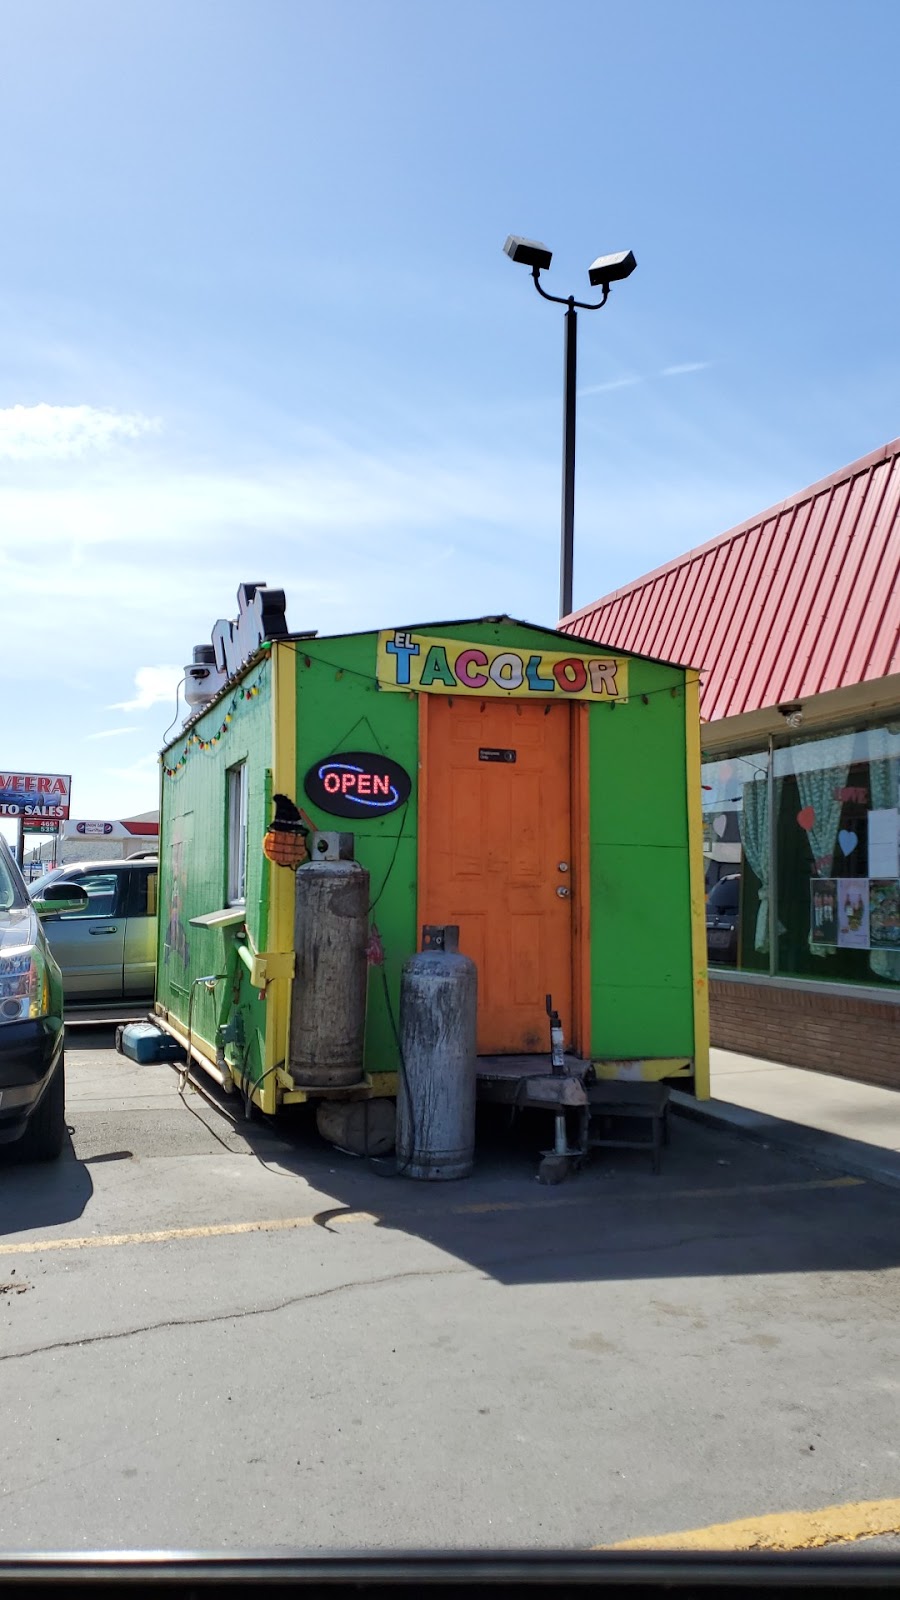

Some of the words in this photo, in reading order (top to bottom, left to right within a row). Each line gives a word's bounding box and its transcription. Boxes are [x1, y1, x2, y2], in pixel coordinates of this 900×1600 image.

[393, 631, 415, 649] EL
[385, 640, 619, 696] TACOLOR
[323, 772, 390, 795] OPEN
[24, 805, 64, 817] SALES
